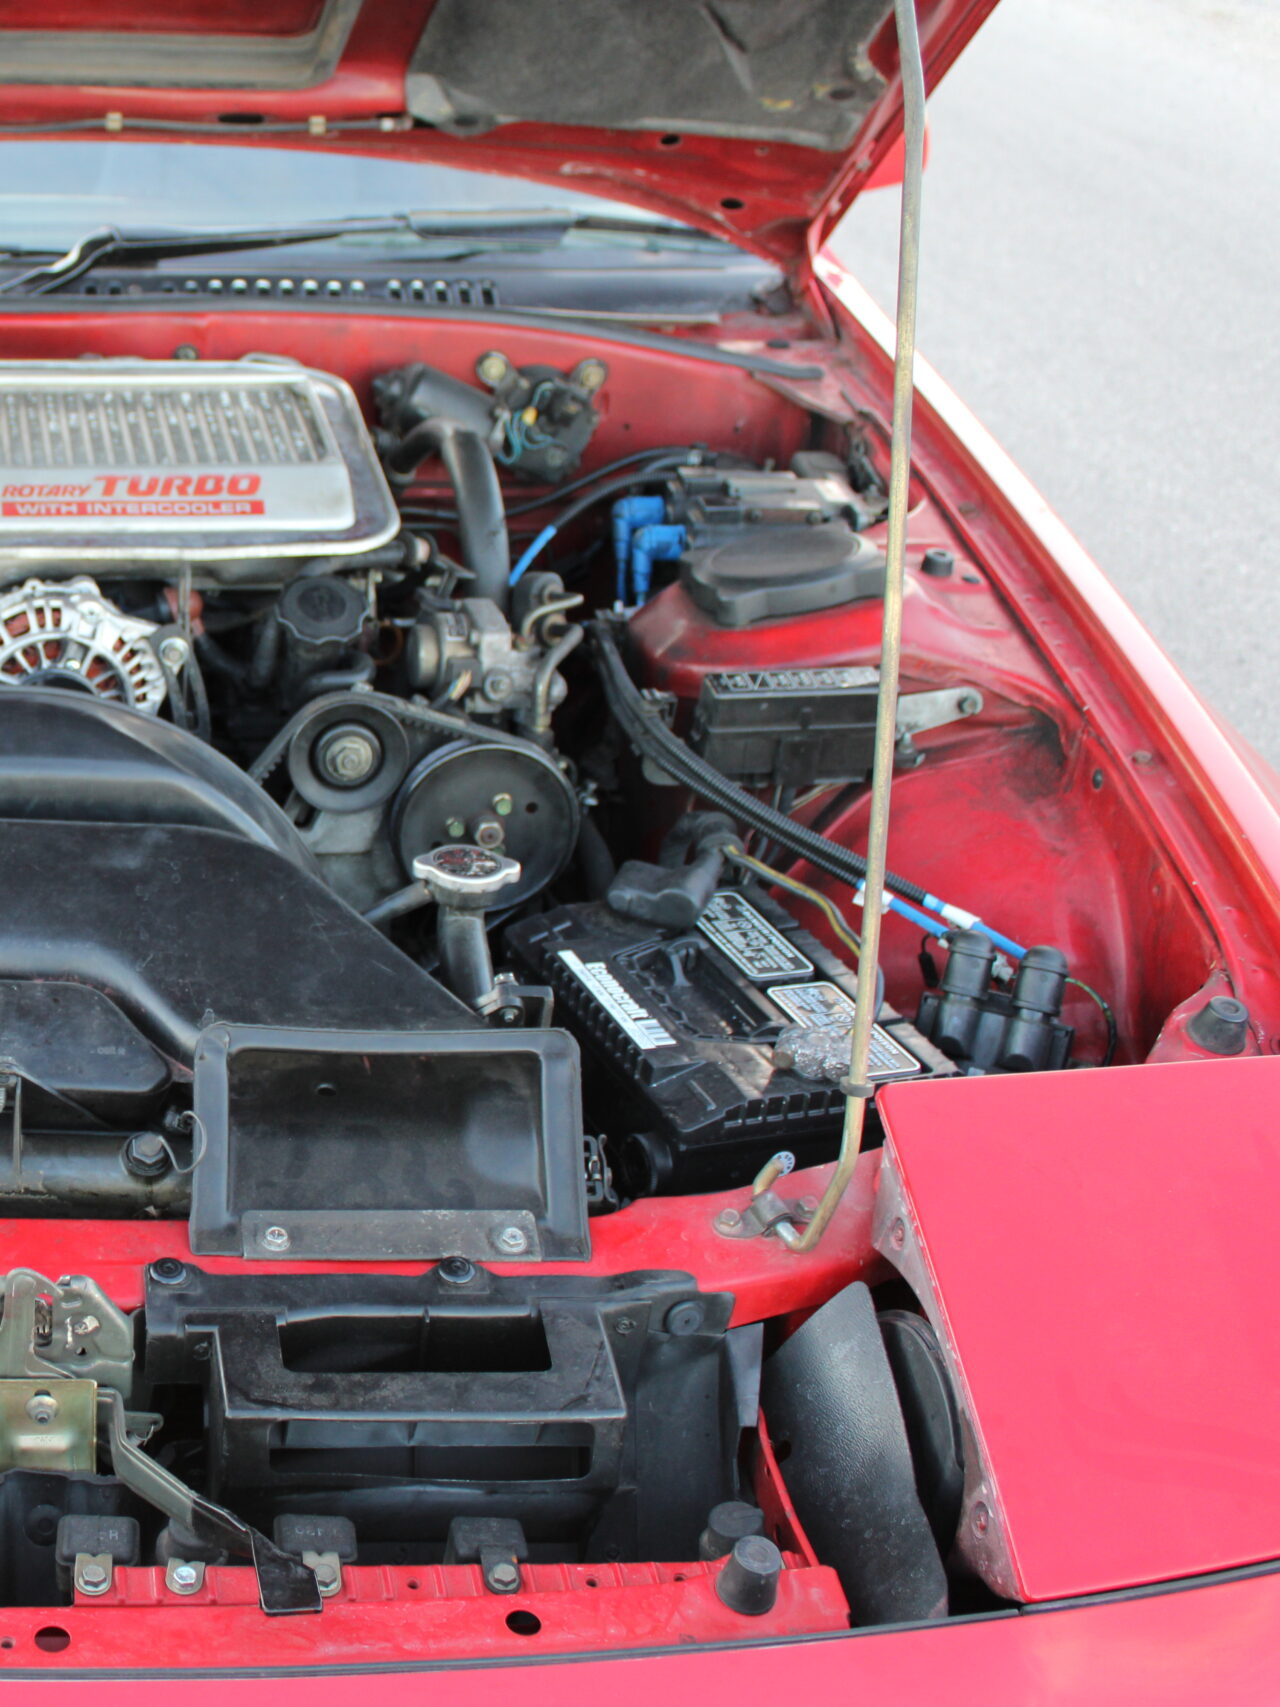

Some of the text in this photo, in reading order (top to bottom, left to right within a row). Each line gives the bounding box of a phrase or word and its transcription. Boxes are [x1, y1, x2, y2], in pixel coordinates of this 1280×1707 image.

[2, 475, 261, 498] ROTARY TURBO
[17, 502, 250, 515] WITH INTERCOOLER
